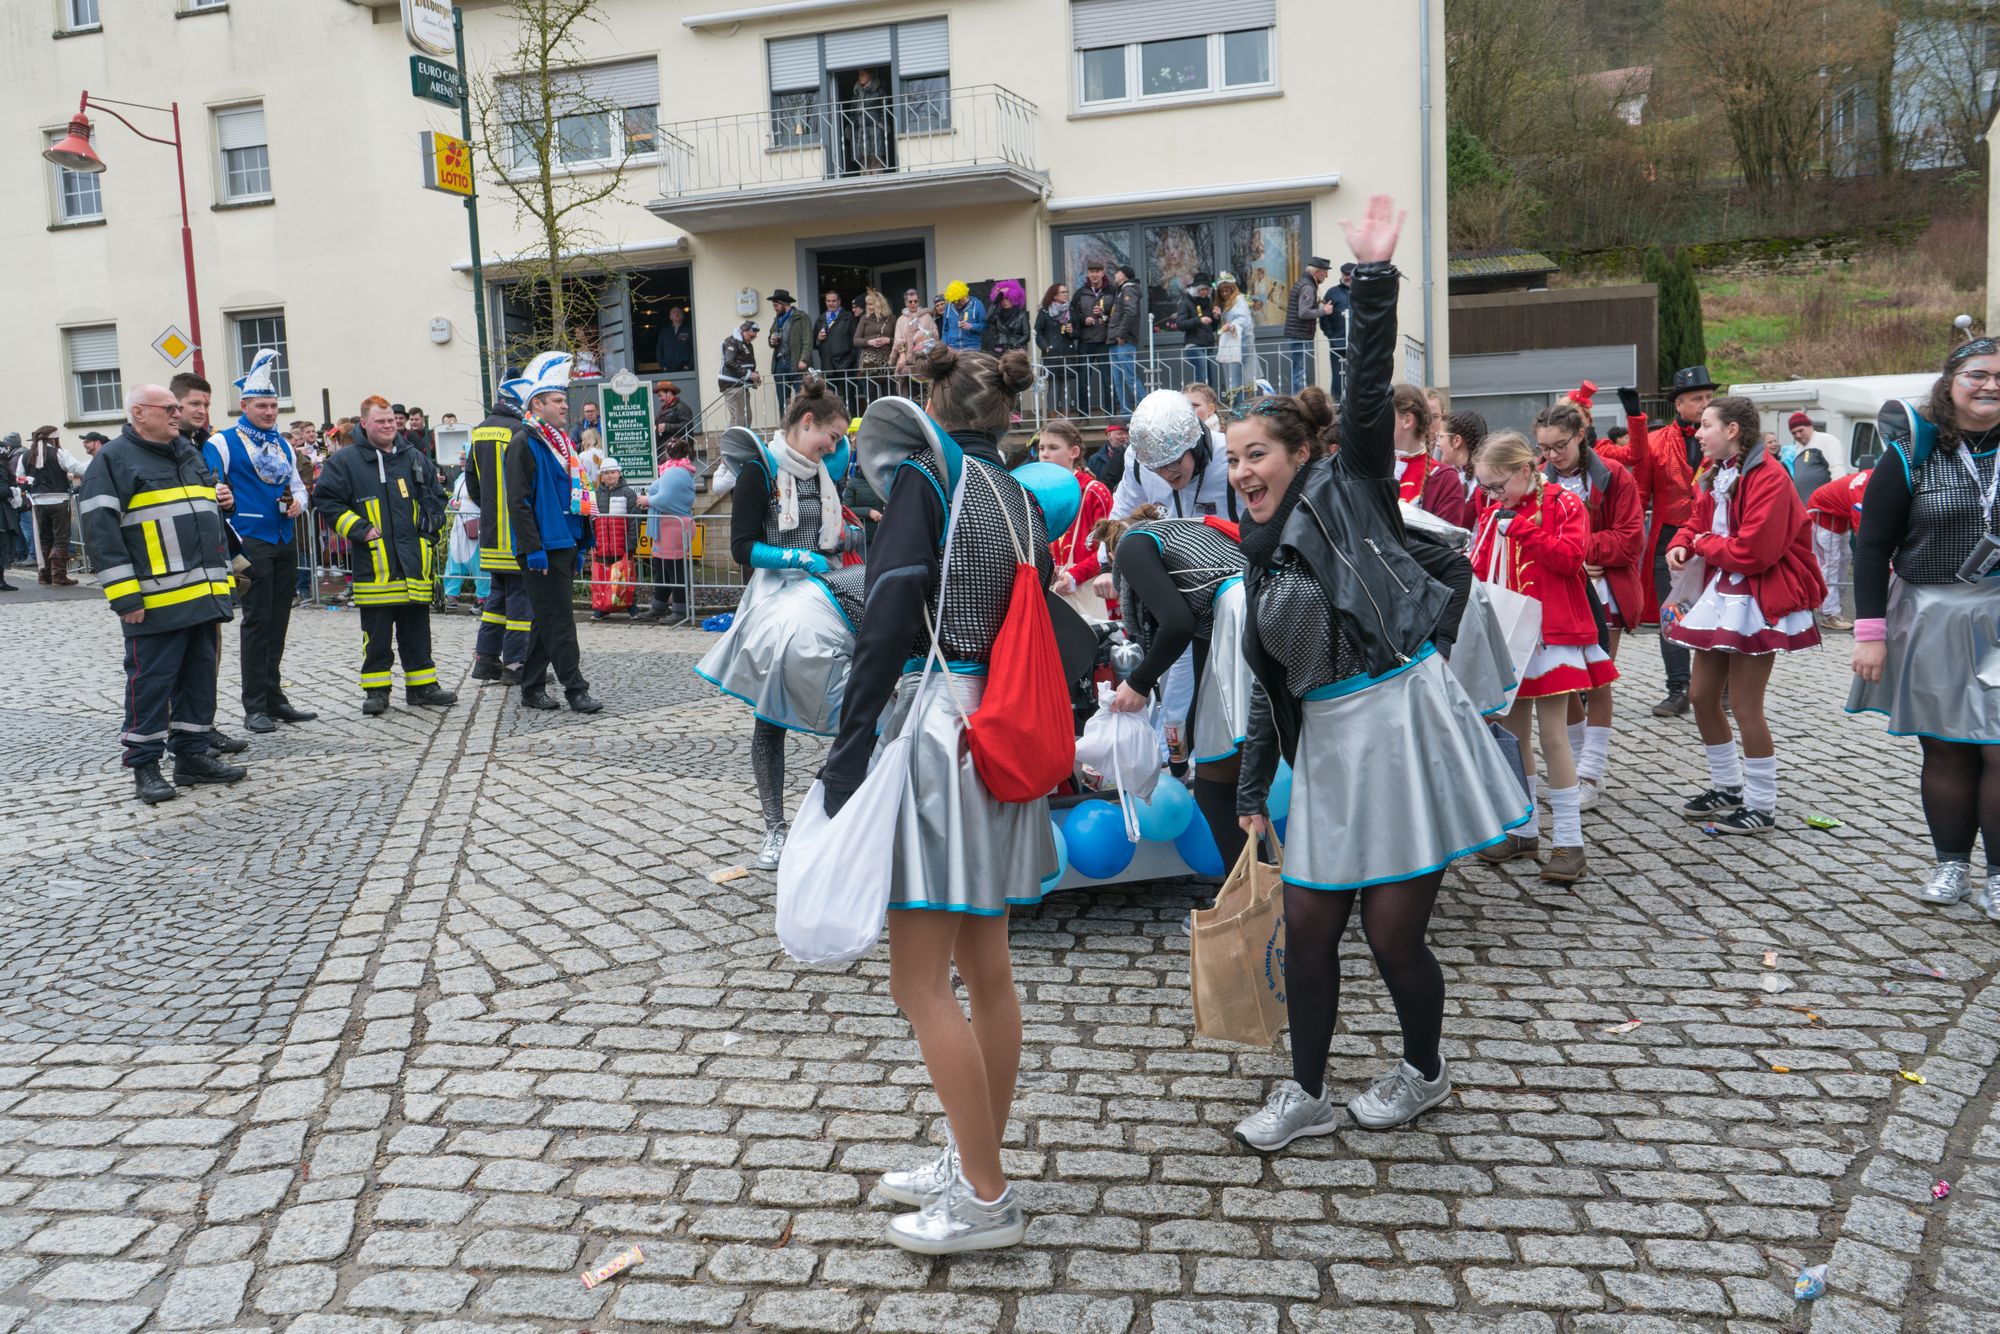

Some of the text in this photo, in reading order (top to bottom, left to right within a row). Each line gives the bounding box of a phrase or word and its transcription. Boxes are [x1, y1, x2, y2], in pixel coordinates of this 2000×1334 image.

[418, 62, 442, 79] EURO
[430, 81, 454, 98] ARENS
[441, 169, 468, 189] LOTTO
